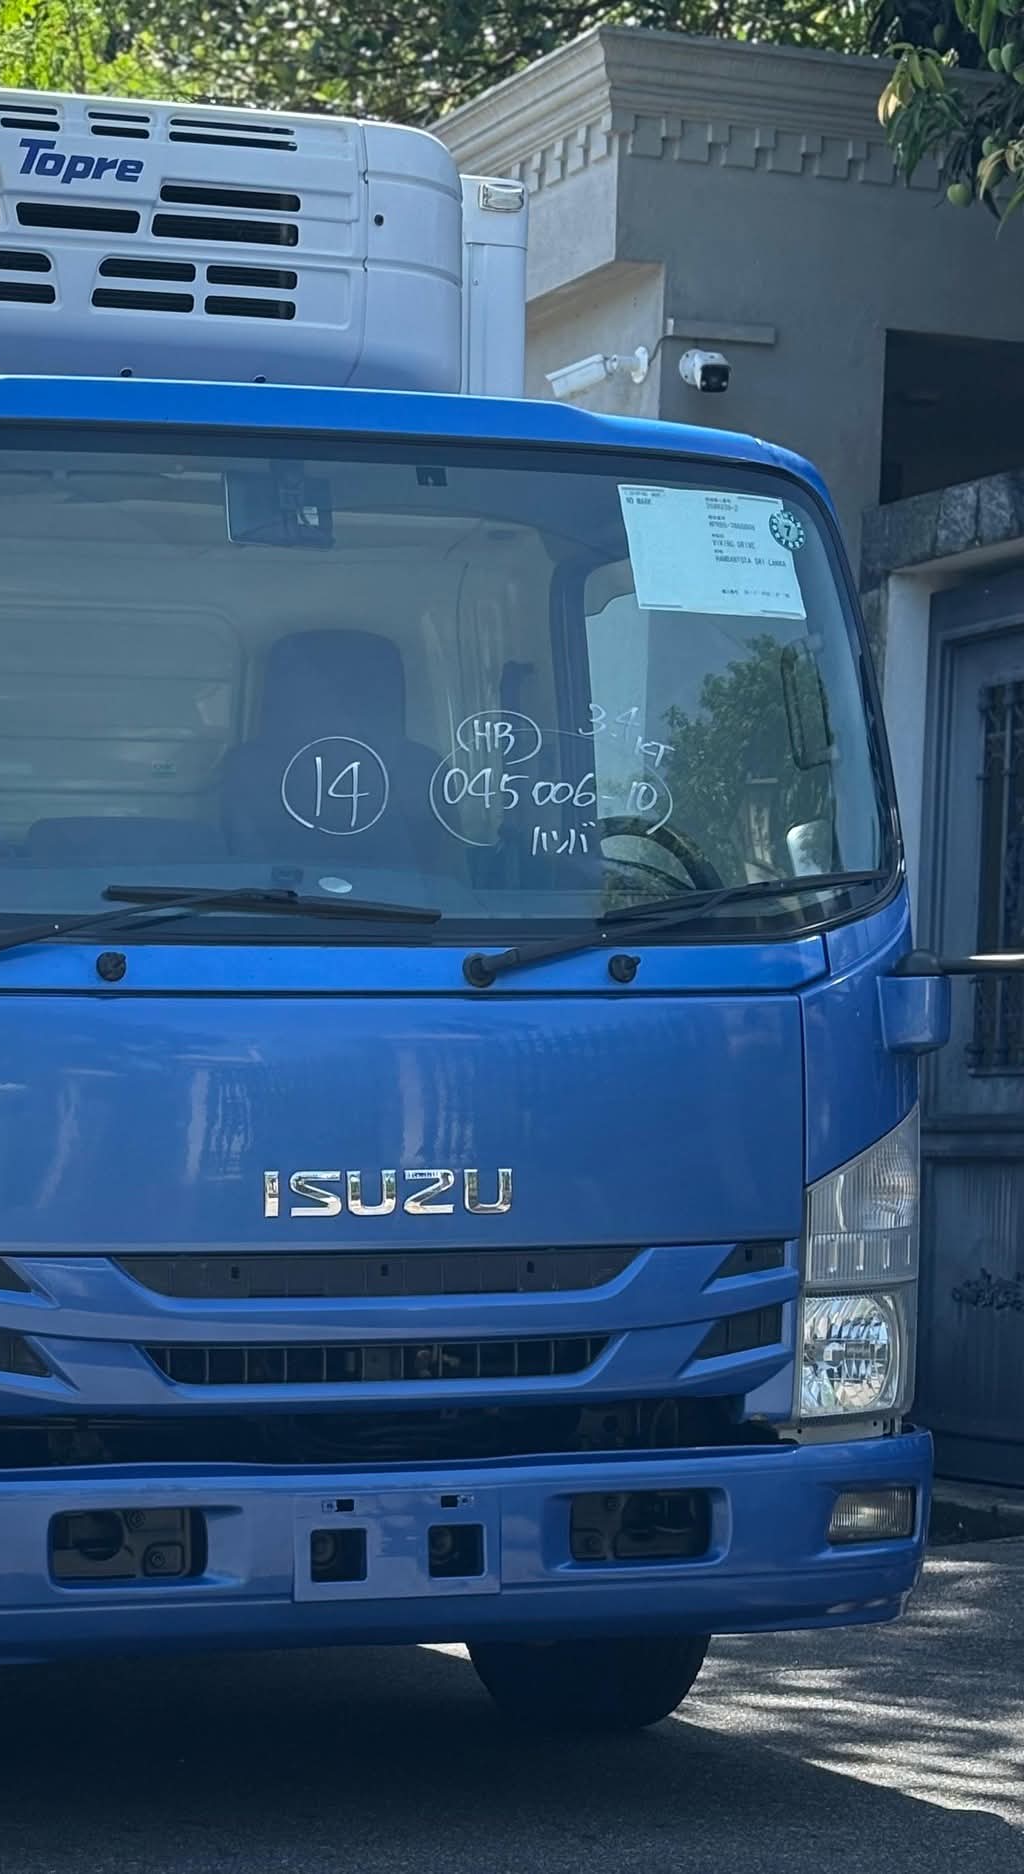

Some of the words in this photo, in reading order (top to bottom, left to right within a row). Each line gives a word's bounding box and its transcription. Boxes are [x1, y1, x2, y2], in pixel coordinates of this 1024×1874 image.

[19, 138, 144, 184] Topre
[783, 525, 791, 537] 7
[314, 756, 370, 828] 14
[263, 1168, 513, 1218] ISUZU
